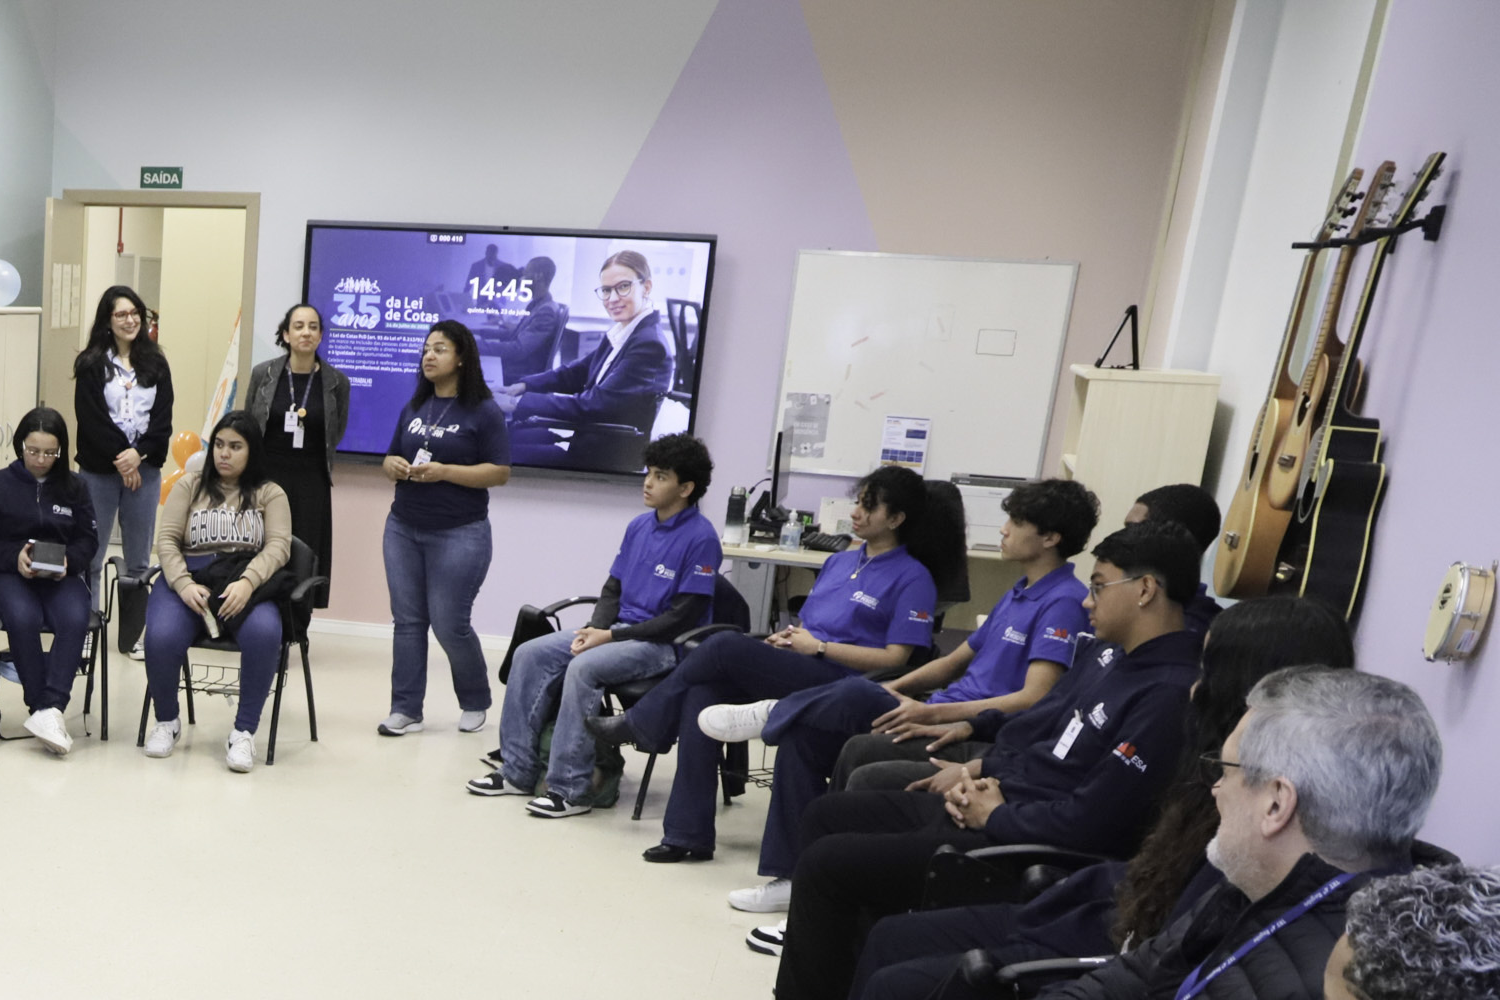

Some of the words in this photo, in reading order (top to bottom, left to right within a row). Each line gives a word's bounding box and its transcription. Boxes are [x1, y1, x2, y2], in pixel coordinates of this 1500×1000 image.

[143, 170, 180, 185] SAÍDA
[469, 277, 533, 302] 14:45
[330, 293, 381, 327] 35
[385, 296, 402, 309] da
[404, 296, 423, 310] Lei
[336, 312, 379, 330] anos
[385, 309, 402, 321] de
[404, 309, 439, 323] Cotas
